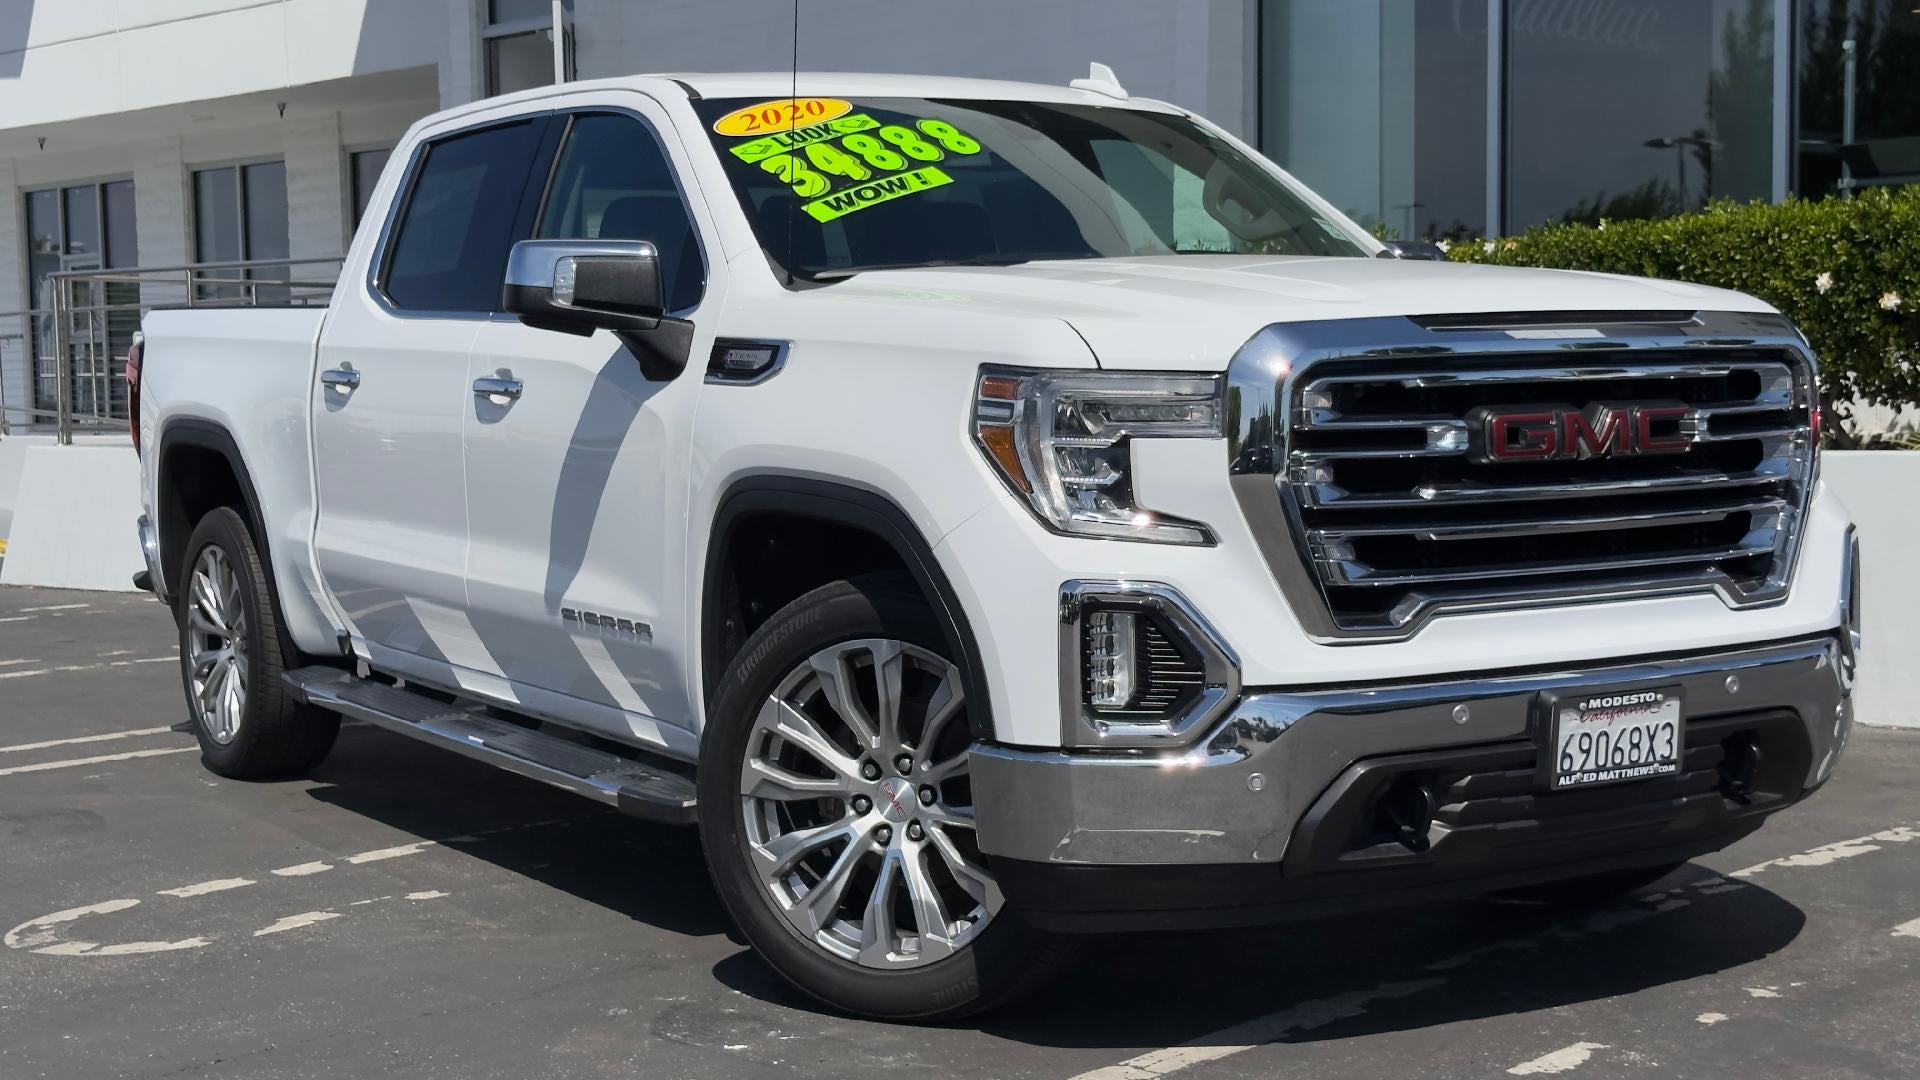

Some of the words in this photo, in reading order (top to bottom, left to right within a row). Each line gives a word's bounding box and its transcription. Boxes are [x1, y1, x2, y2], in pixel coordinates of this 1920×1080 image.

[739, 100, 826, 131] 2020
[771, 121, 842, 148] LOOK
[760, 119, 981, 197] 34888
[1486, 404, 1694, 459] GMC
[561, 607, 653, 637] SIERRA
[736, 605, 824, 684] BRIDGESTONE
[1588, 692, 1656, 709] MODESTO
[1560, 722, 1674, 772] 69068X3
